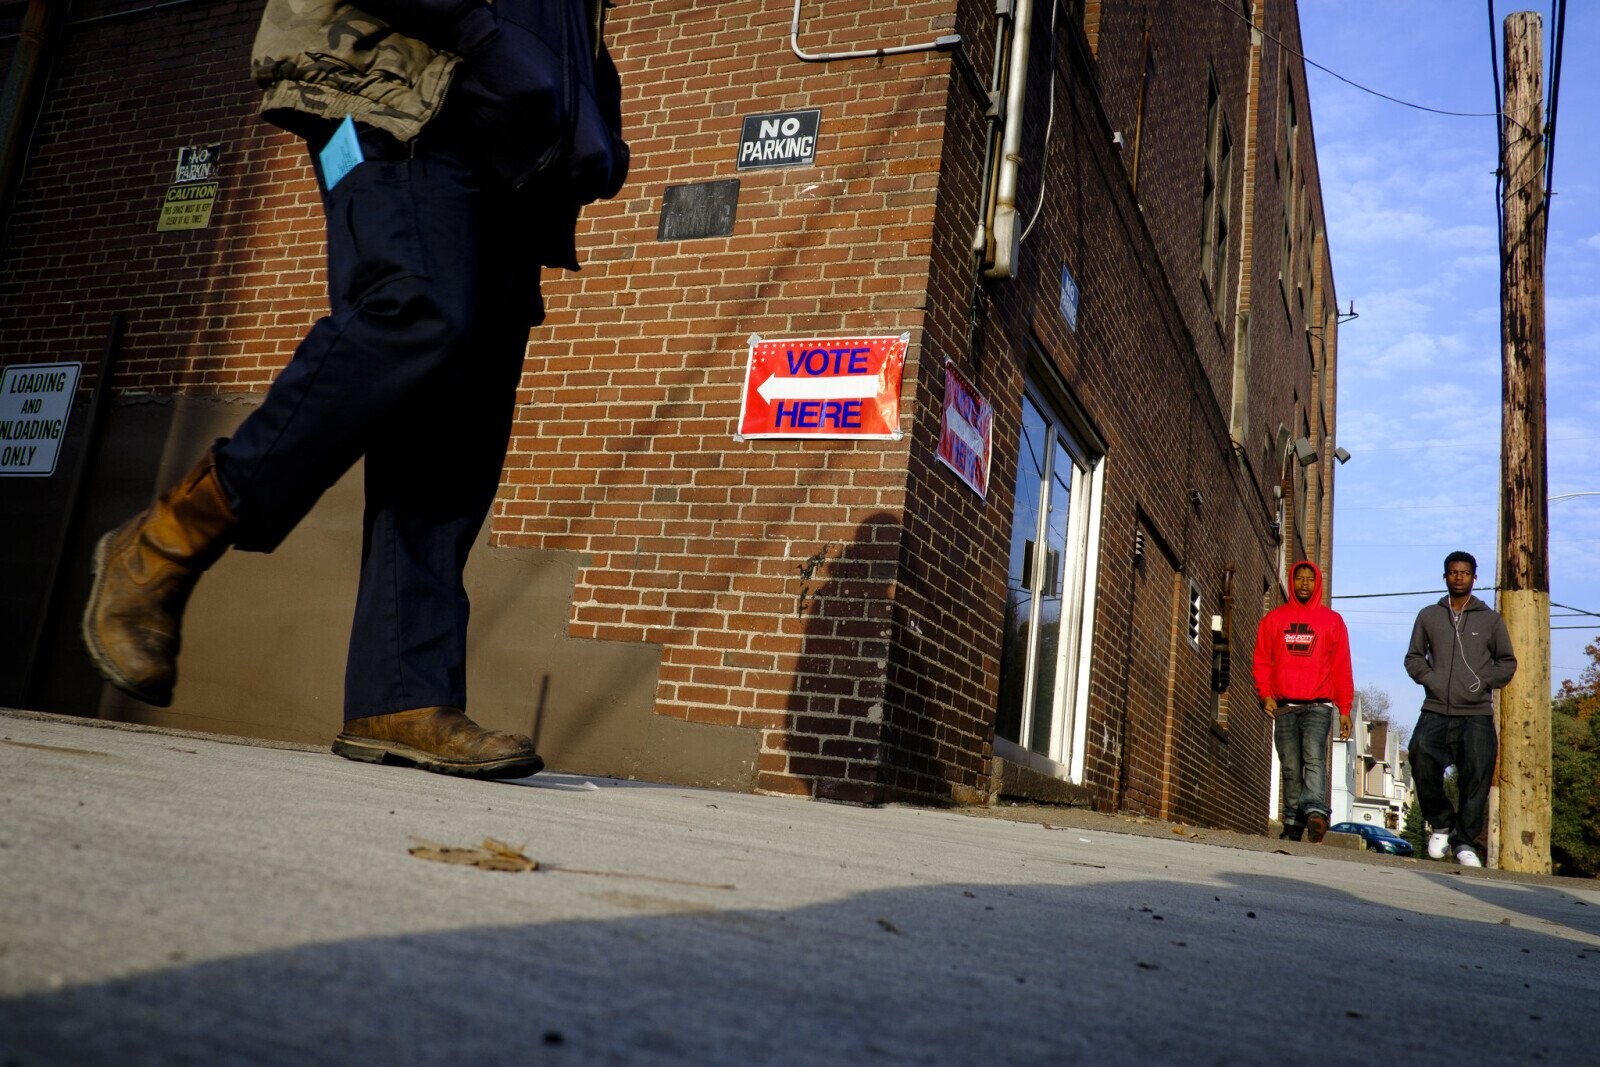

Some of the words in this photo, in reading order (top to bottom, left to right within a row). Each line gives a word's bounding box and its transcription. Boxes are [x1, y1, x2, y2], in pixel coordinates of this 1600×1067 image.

[759, 118, 800, 139] NO
[741, 136, 813, 162] PARKING
[179, 163, 212, 180] PARKIN
[168, 186, 216, 200] CAUTION
[786, 348, 870, 375] VOTE
[10, 372, 66, 394] LOADING
[20, 399, 42, 414] AND
[775, 401, 863, 428] HERE
[1, 446, 37, 467] ONLY
